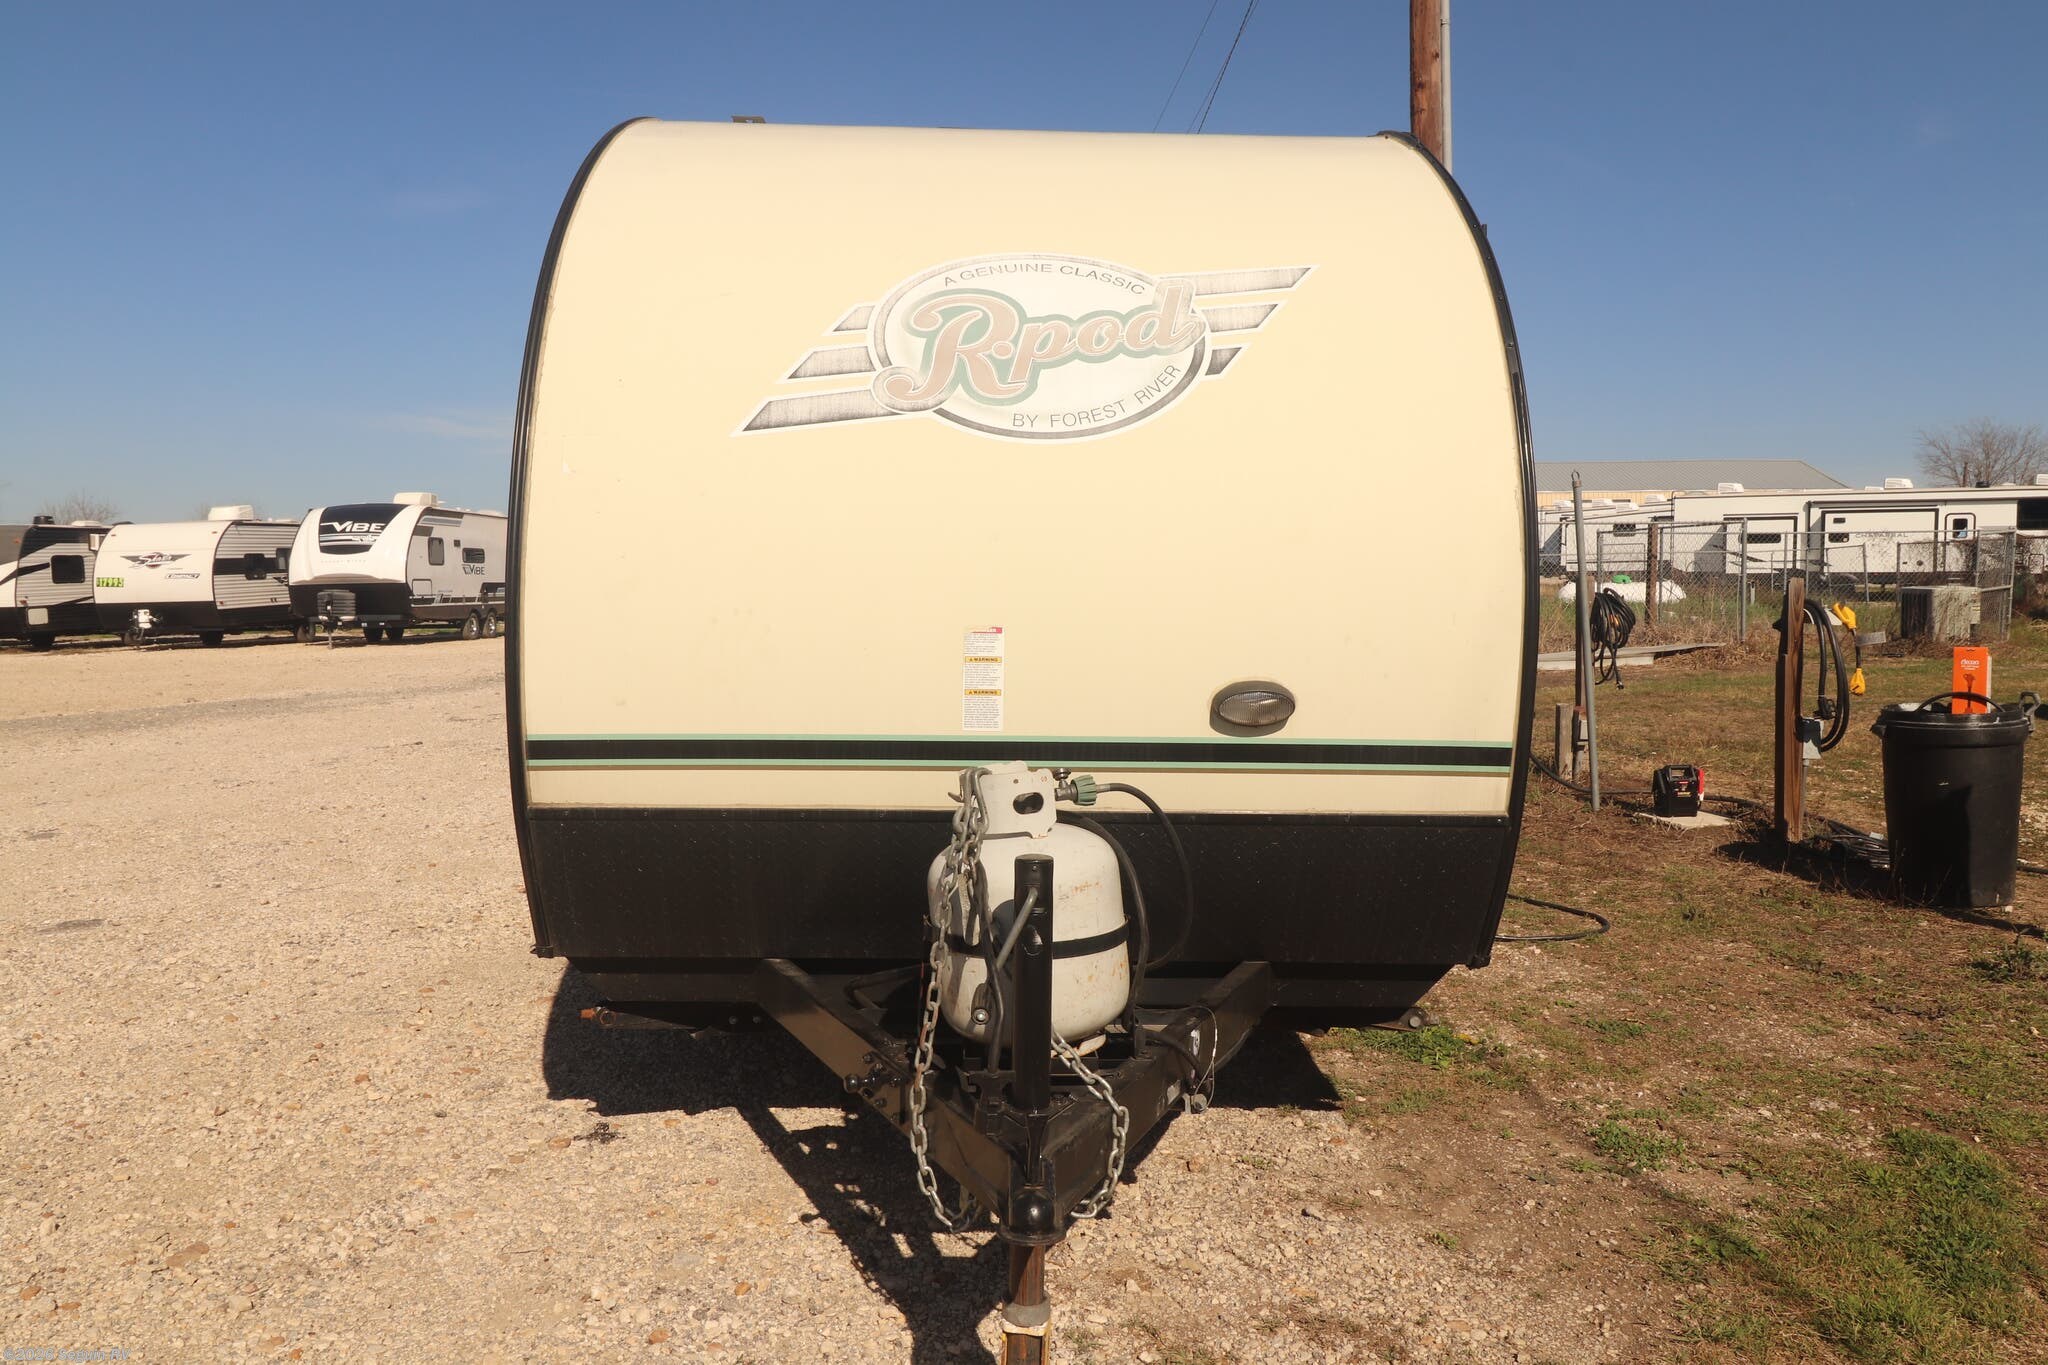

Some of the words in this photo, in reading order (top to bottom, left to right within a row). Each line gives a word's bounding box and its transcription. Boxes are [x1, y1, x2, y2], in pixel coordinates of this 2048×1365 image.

[944, 276, 957, 287] A
[959, 263, 1053, 281] GENUINE
[1059, 265, 1146, 295] CLASSIC
[1012, 413, 1039, 428] BY
[1050, 400, 1127, 428] FOREST
[1134, 364, 1182, 404] RIVER
[331, 521, 386, 532] VIBE
